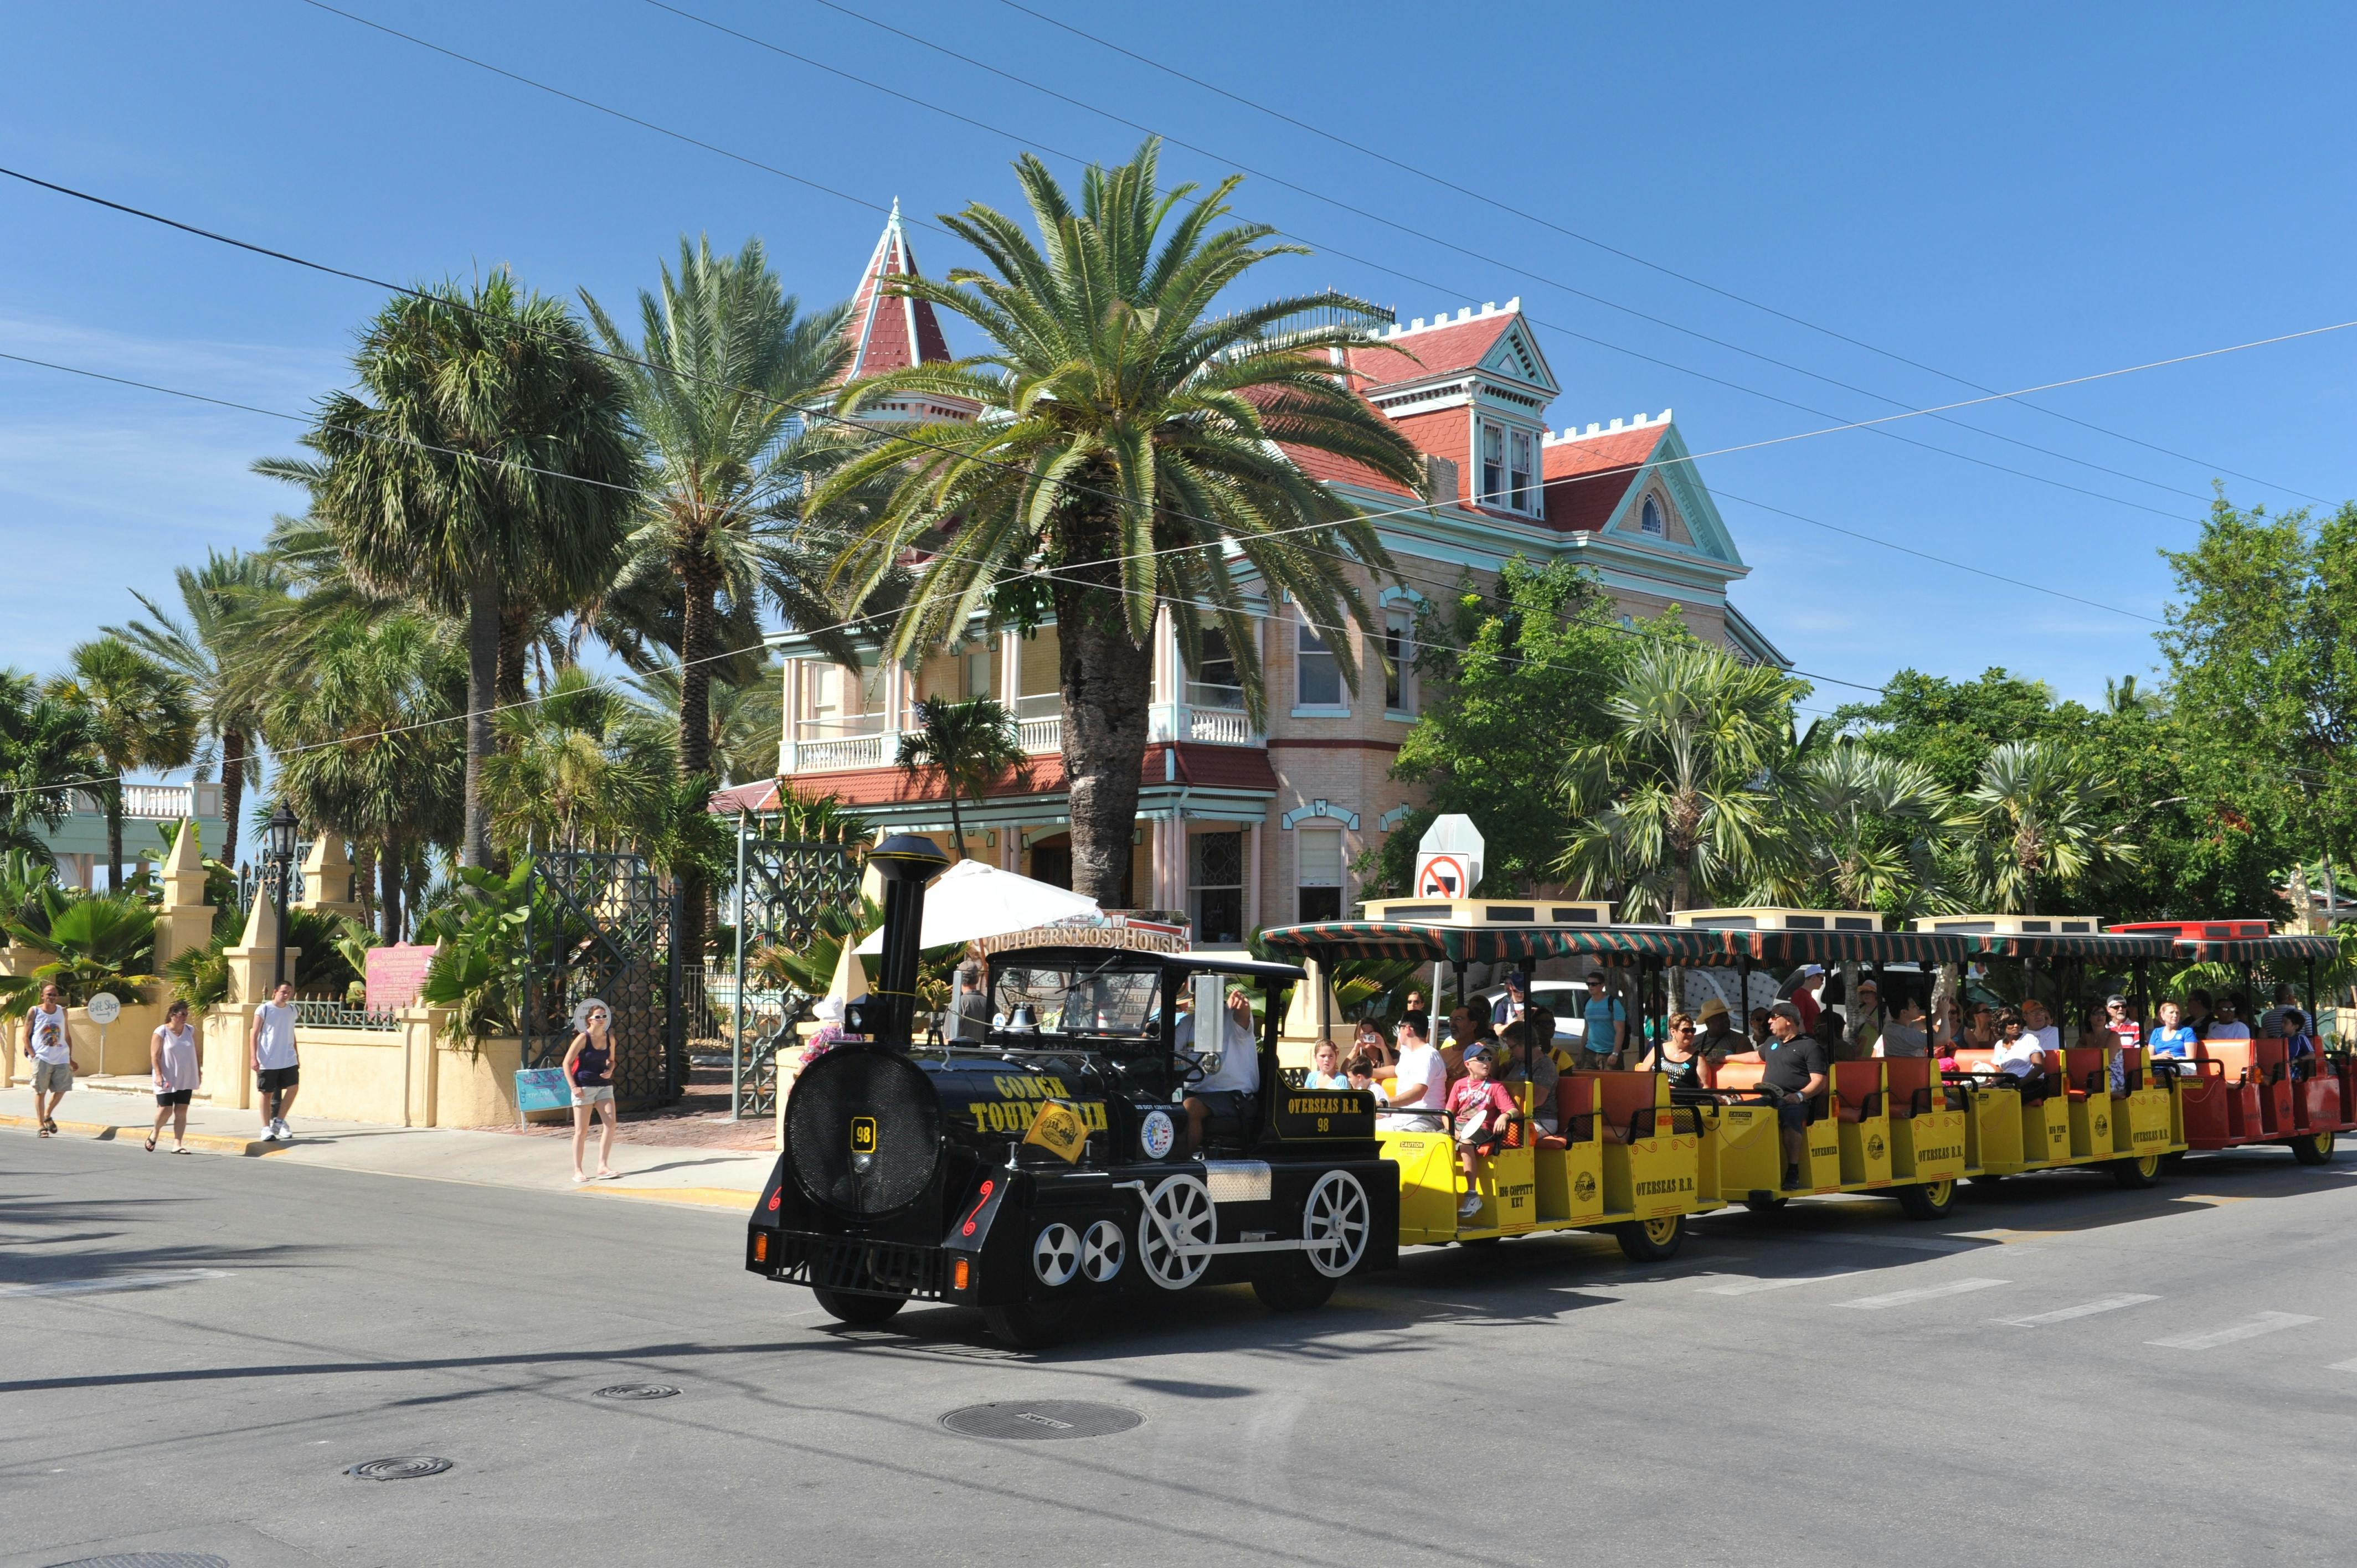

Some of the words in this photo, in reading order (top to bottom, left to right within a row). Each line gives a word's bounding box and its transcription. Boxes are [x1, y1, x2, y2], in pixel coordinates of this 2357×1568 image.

[1122, 926, 1186, 953] HOUSE
[1006, 991, 1042, 1003] Guest
[90, 1001, 104, 1012] Gift
[104, 999, 119, 1012] Shop
[993, 1076, 1072, 1099] CONCH
[1288, 1098, 1339, 1114] OVERSEAS
[1342, 1098, 1362, 1113] R.R.
[1317, 1118, 1329, 1132] 98
[857, 1126, 871, 1143] 98
[2133, 1131, 2158, 1143] OVERSEAS
[1811, 1145, 1838, 1157] TAVERNIER
[1918, 1147, 1949, 1162] OVERSEAS
[1951, 1145, 1963, 1158] R.R.
[1499, 1187, 1509, 1198] BIG
[1510, 1184, 1534, 1196] COPPITT
[1636, 1179, 1676, 1196] OVERSEAS
[1679, 1177, 1695, 1192] R.R.
[1511, 1196, 1524, 1208] KEY
